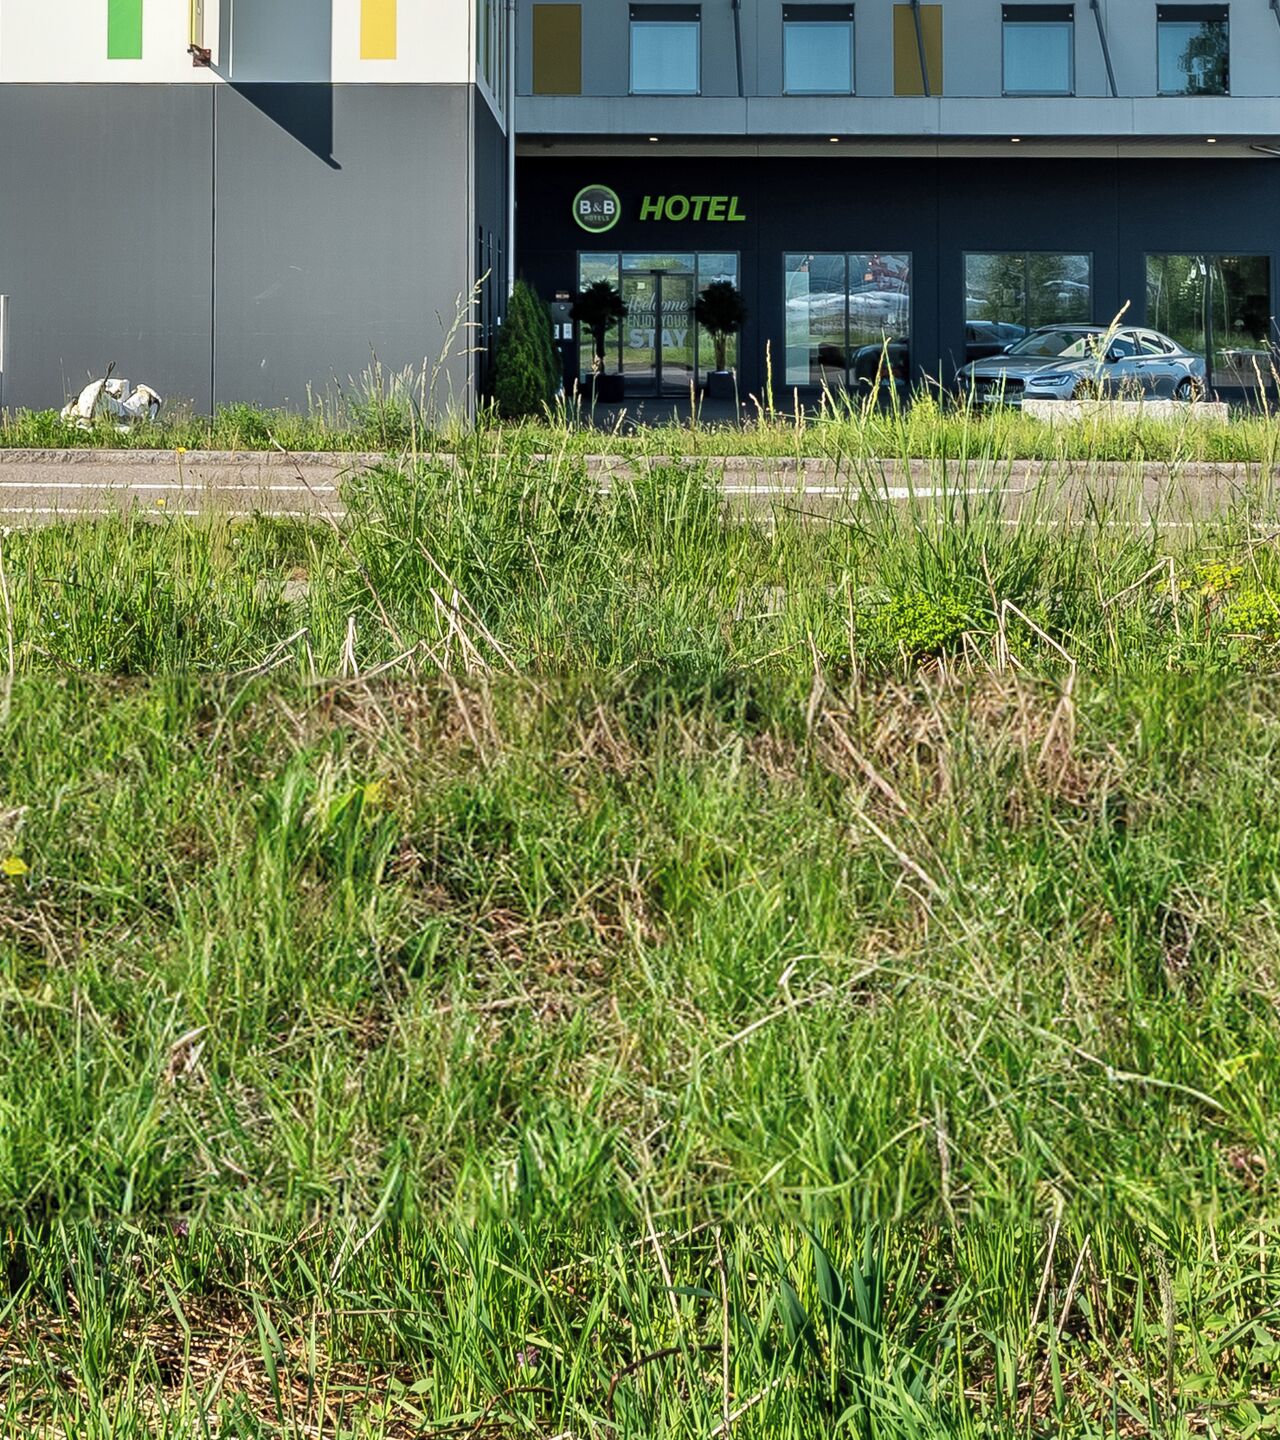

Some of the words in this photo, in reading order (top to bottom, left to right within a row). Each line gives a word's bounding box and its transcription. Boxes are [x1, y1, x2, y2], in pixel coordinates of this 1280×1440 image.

[579, 200, 615, 215] B&B
[639, 195, 746, 221] HOTEL
[628, 328, 689, 349] STAY
